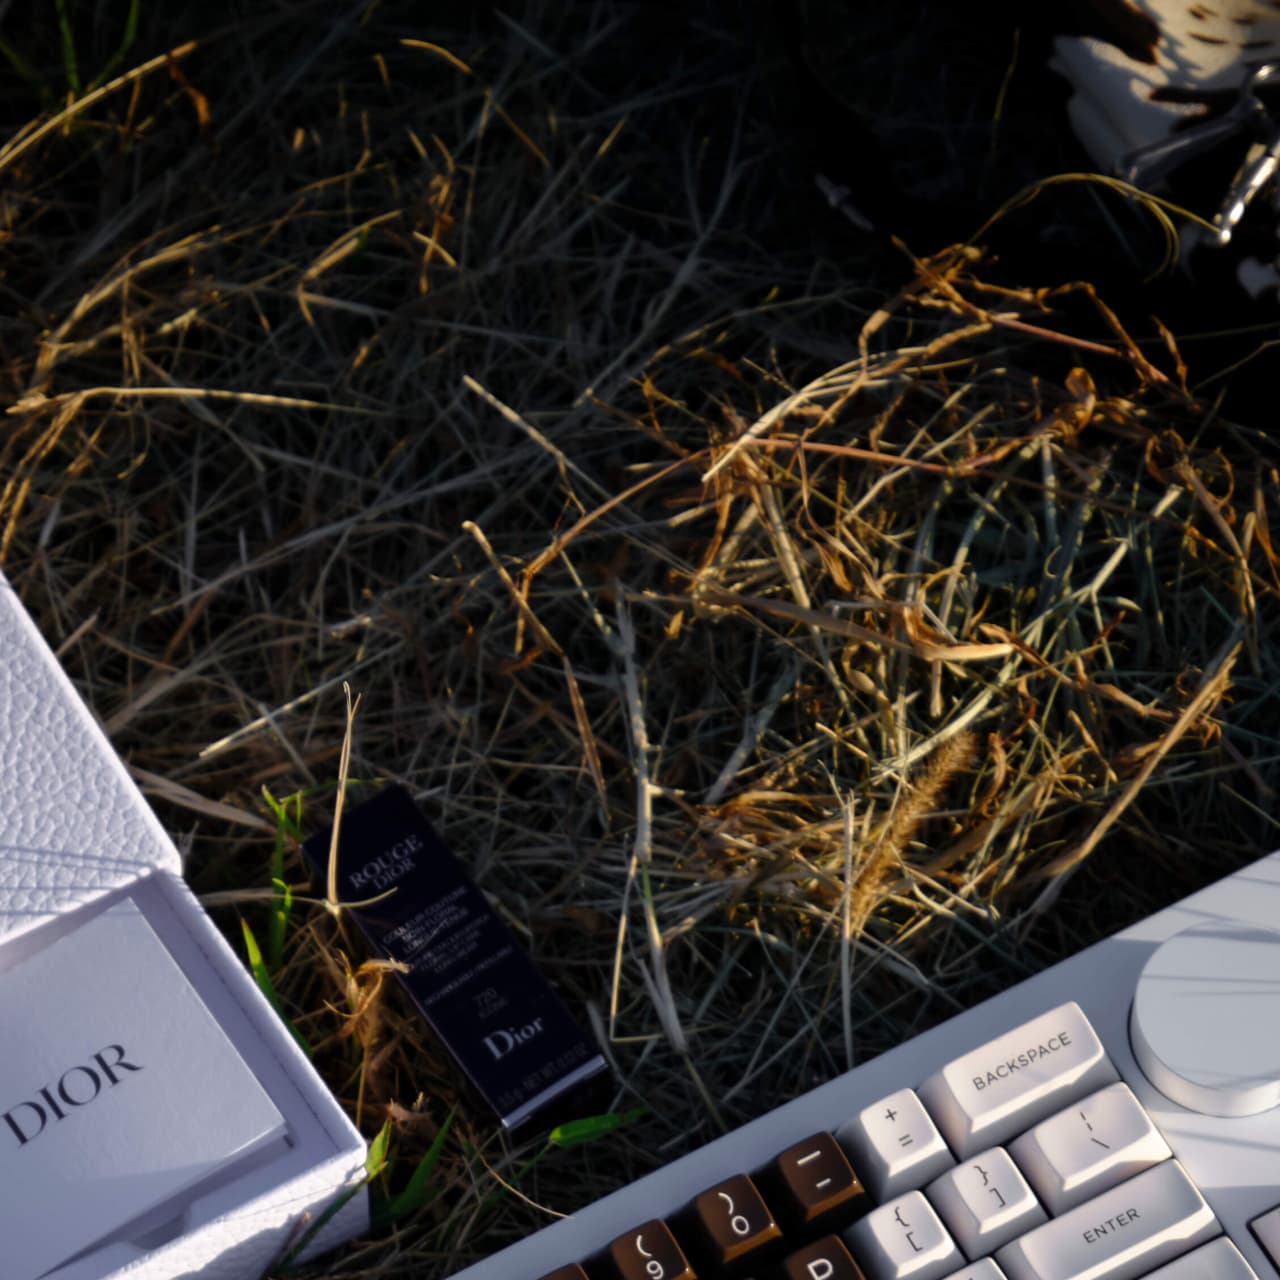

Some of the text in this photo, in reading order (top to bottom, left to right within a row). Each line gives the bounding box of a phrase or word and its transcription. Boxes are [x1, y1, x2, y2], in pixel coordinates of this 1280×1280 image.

[349, 835, 422, 889] ROUGE
[371, 857, 416, 891] DIOR
[484, 1018, 542, 1059] Dior
[972, 1032, 1071, 1091] BACKSPACE
[0, 1043, 143, 1147] DIOR
[886, 1109, 896, 1121] +
[899, 1134, 913, 1147] =
[974, 1165, 988, 1186] }
[718, 1193, 733, 1214] )
[989, 1188, 1006, 1208] ]
[732, 1216, 749, 1235] 0
[895, 1207, 910, 1227] {
[1083, 1209, 1140, 1243] ENTER
[636, 1235, 652, 1257] (
[906, 1232, 923, 1252] [
[646, 1261, 663, 1280] 9
